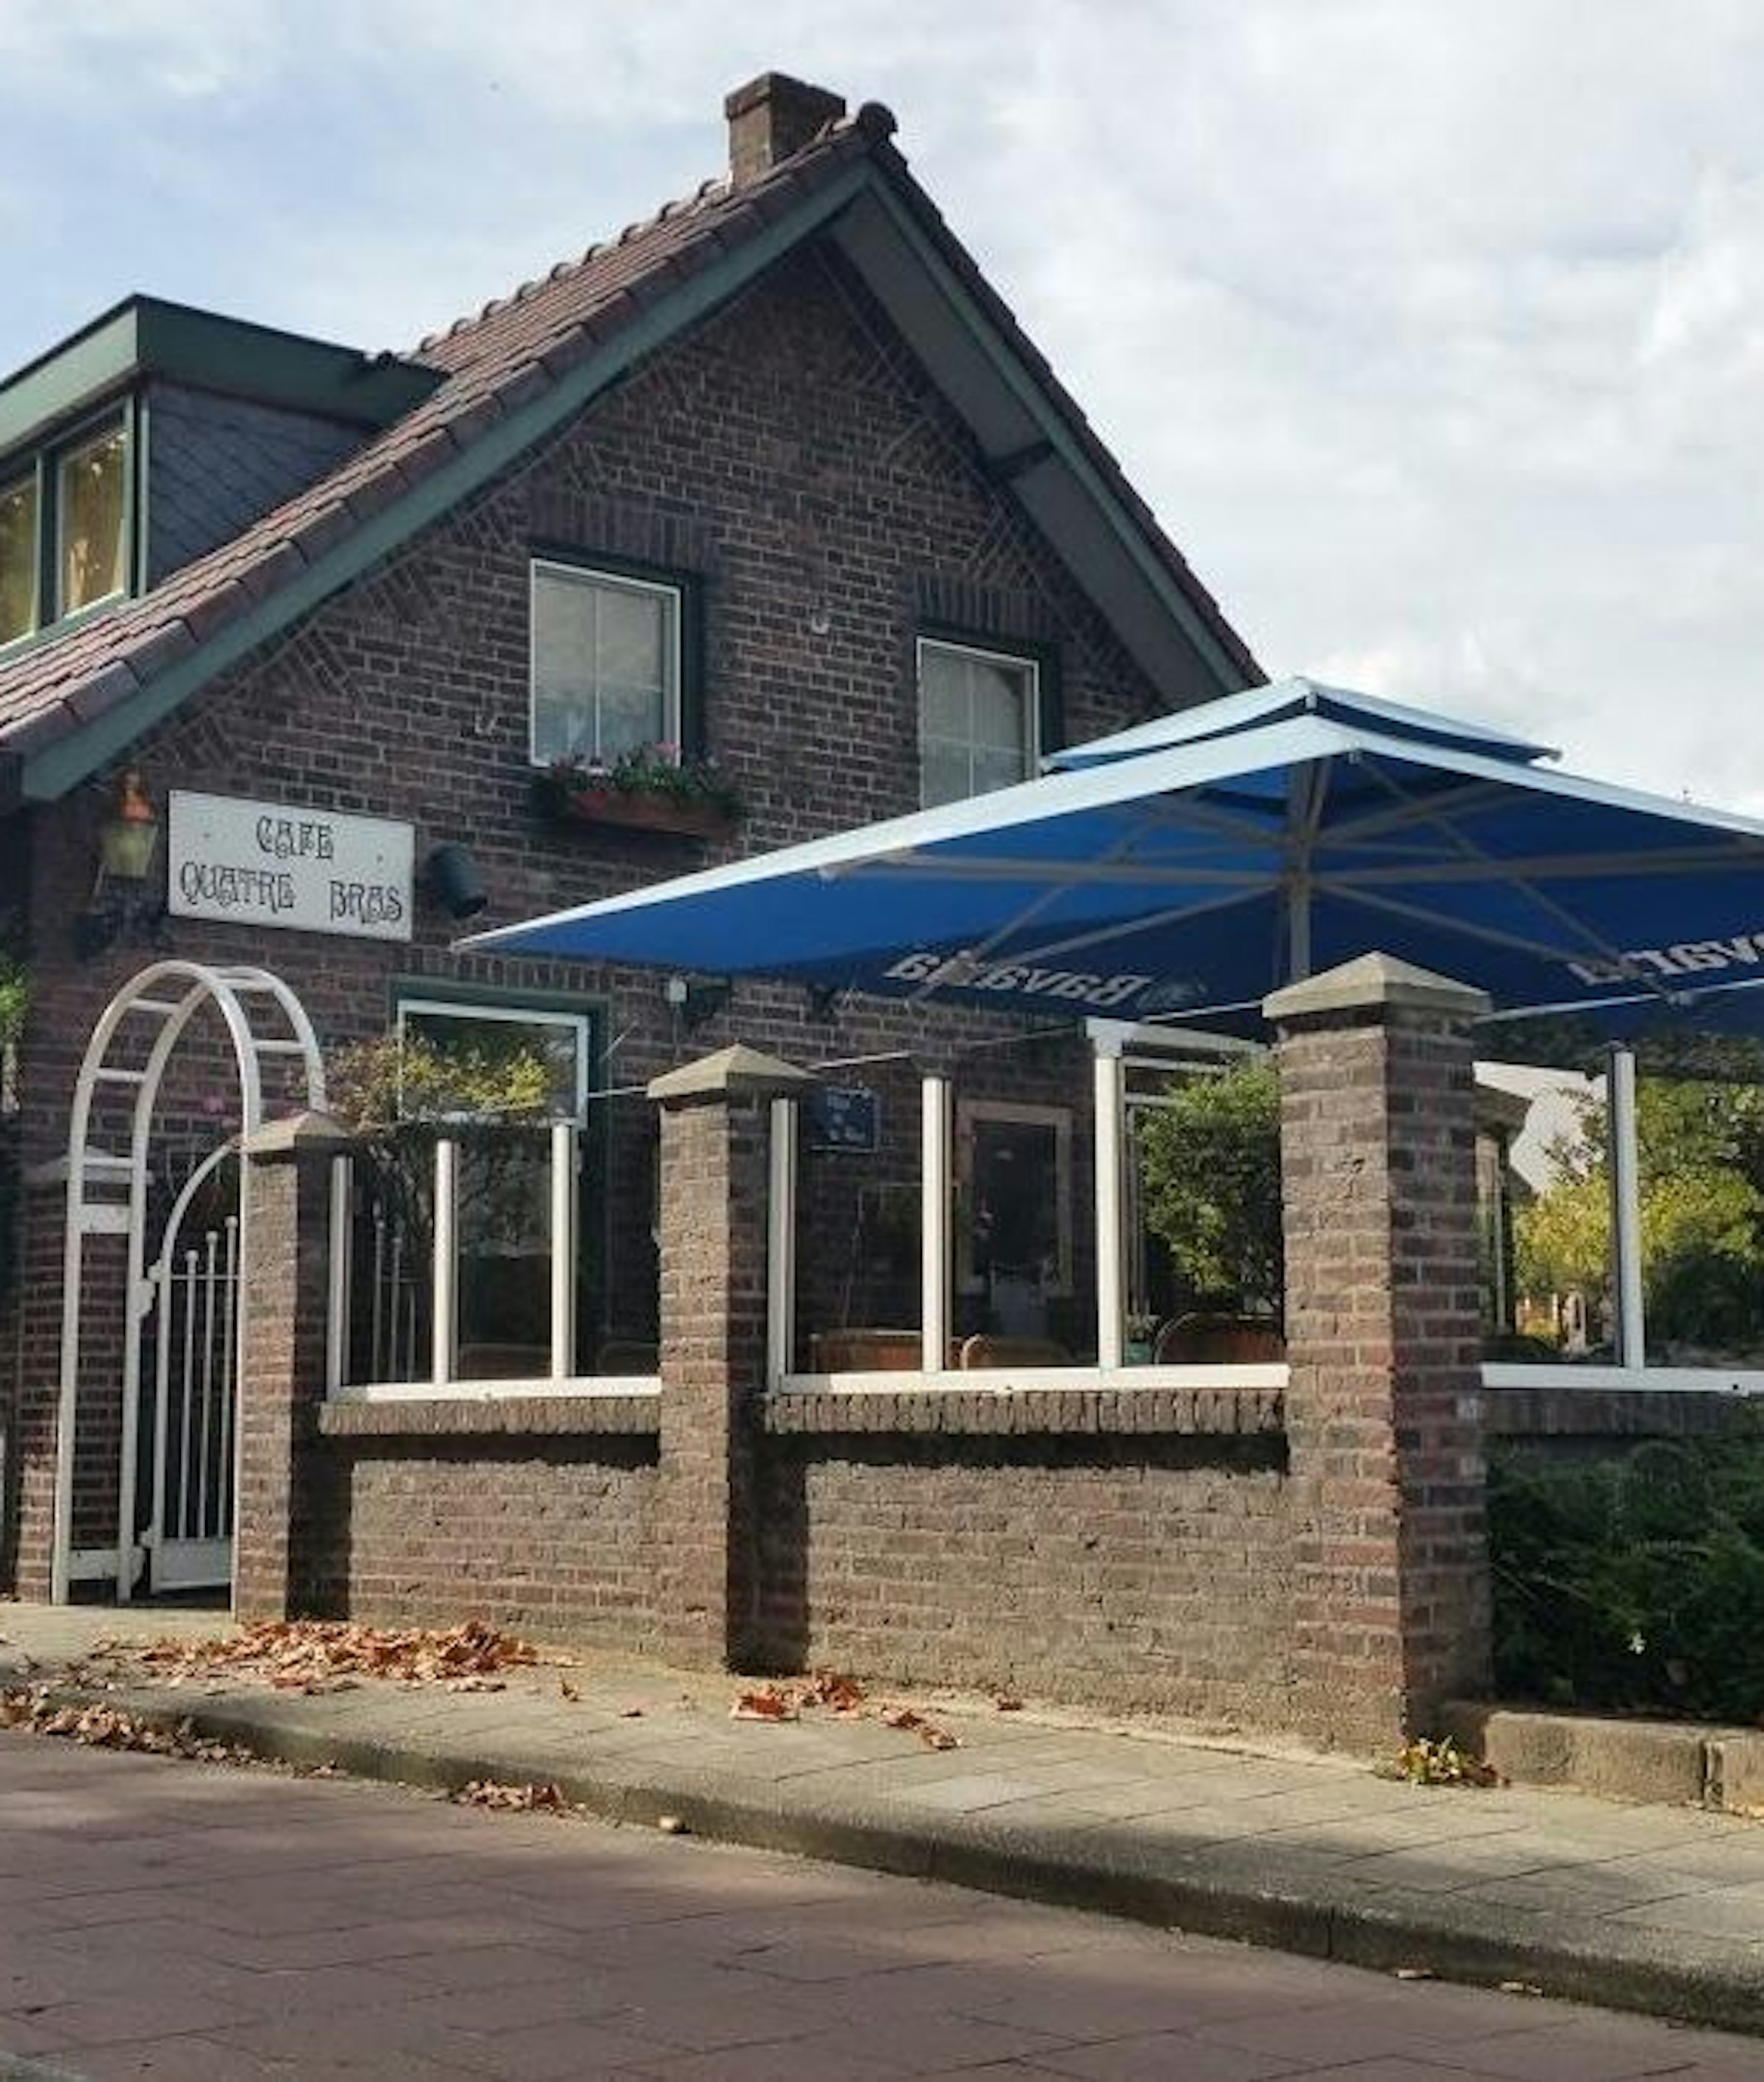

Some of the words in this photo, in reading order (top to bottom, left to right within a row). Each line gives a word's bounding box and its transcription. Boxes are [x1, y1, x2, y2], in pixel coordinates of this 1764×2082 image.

[256, 816, 333, 859] CAFE
[181, 861, 296, 913] QUATRE
[330, 880, 402, 923] BRAS
